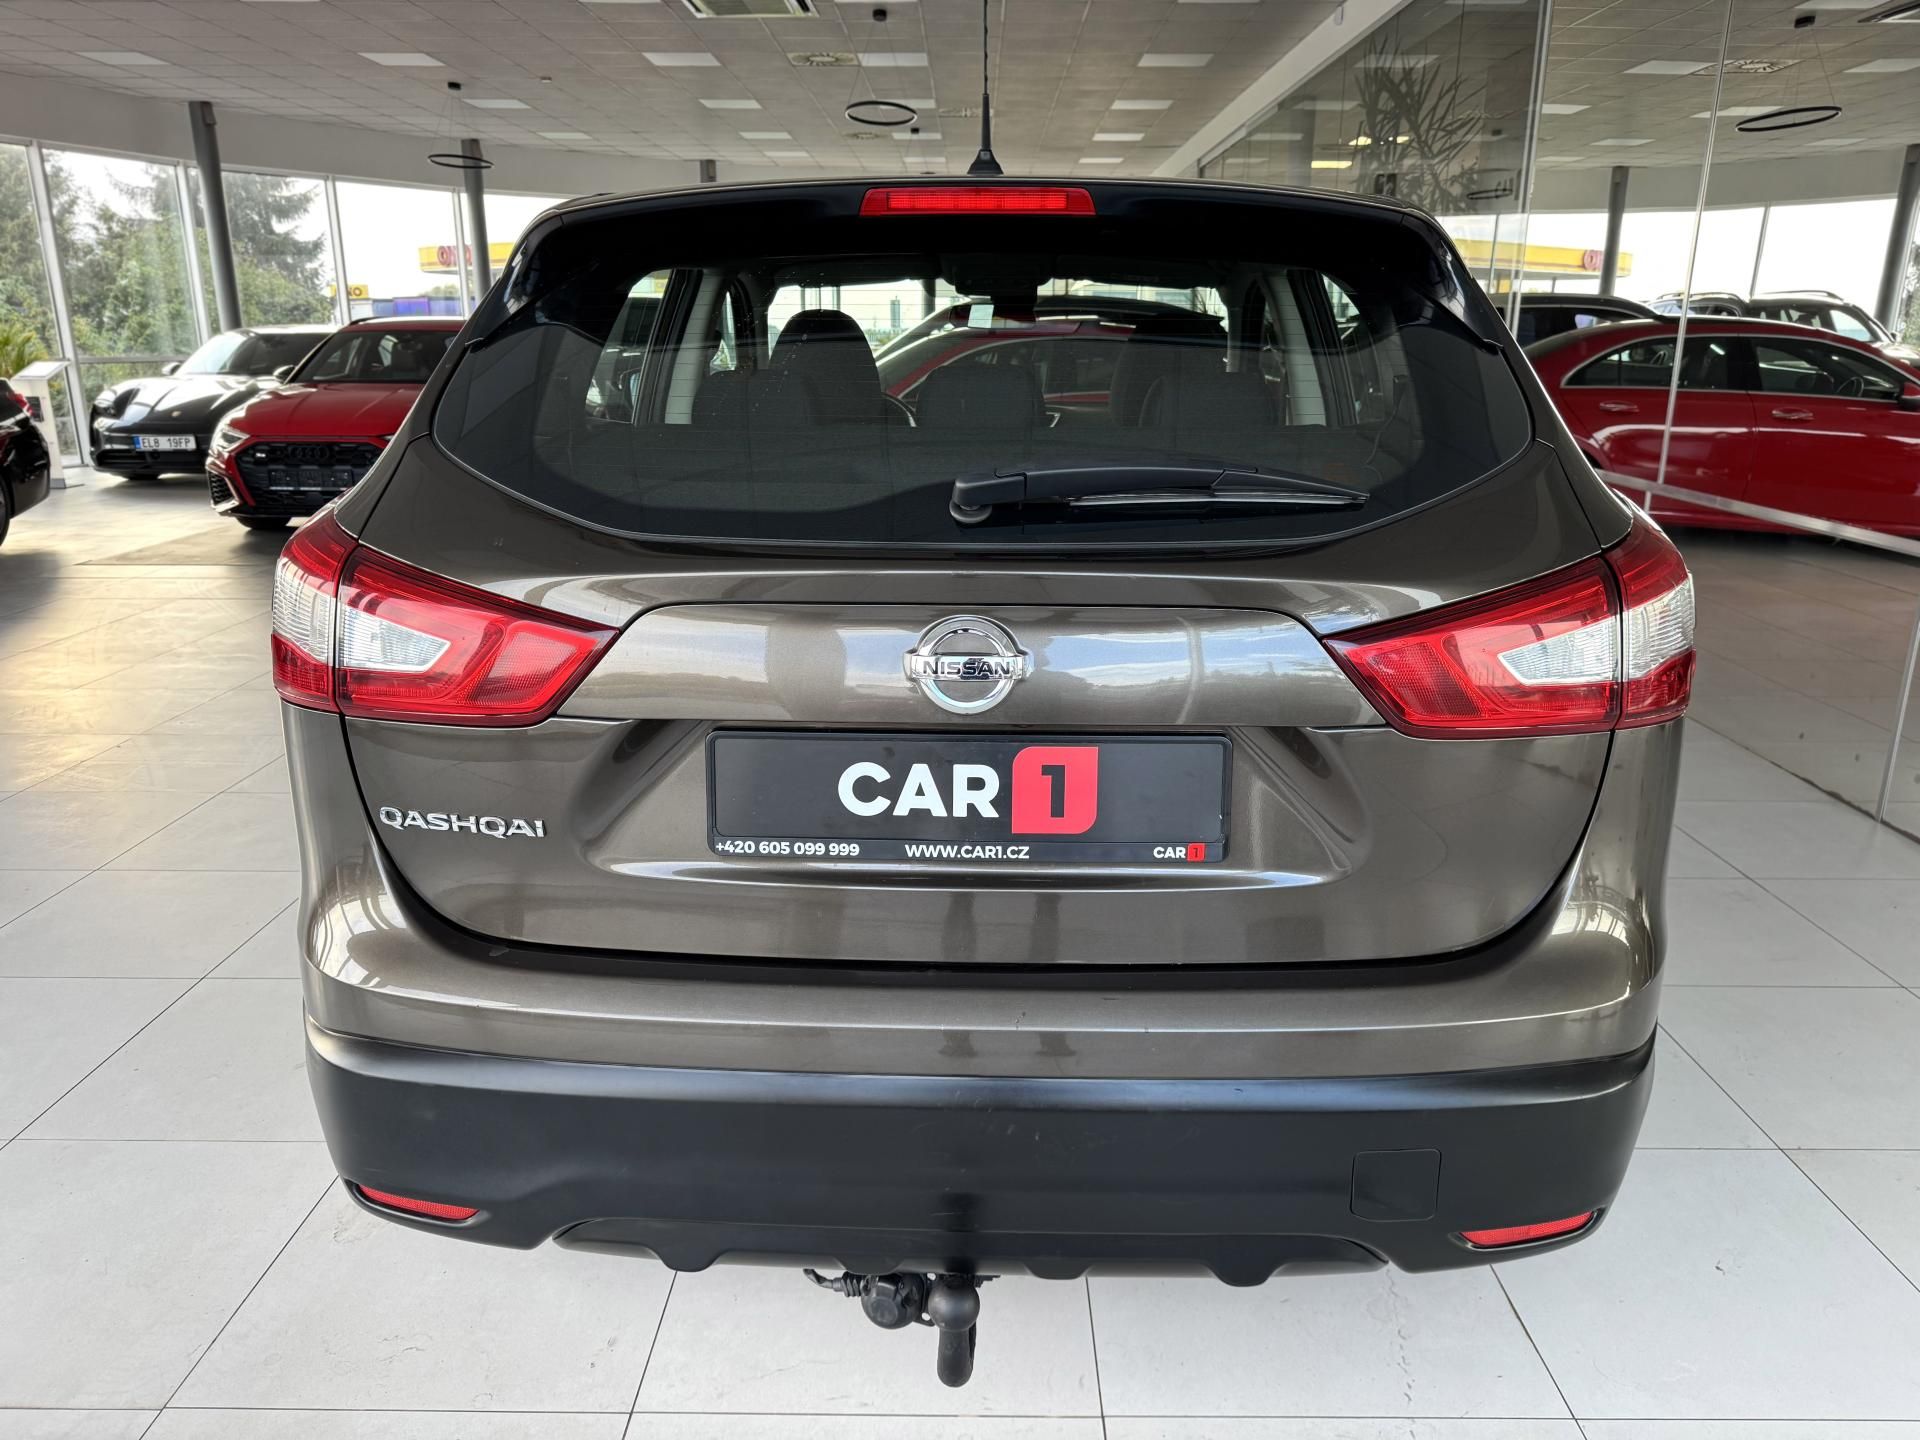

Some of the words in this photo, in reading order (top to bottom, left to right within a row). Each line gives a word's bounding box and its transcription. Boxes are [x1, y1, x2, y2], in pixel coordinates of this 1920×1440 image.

[923, 660, 1010, 675] NISSAN
[379, 806, 547, 839] QASHQAI
[716, 841, 756, 853] +420
[759, 841, 791, 854] 605
[793, 842, 826, 855] 099
[828, 843, 860, 856] 999
[904, 844, 1030, 859] WWW.CAR1.CZ
